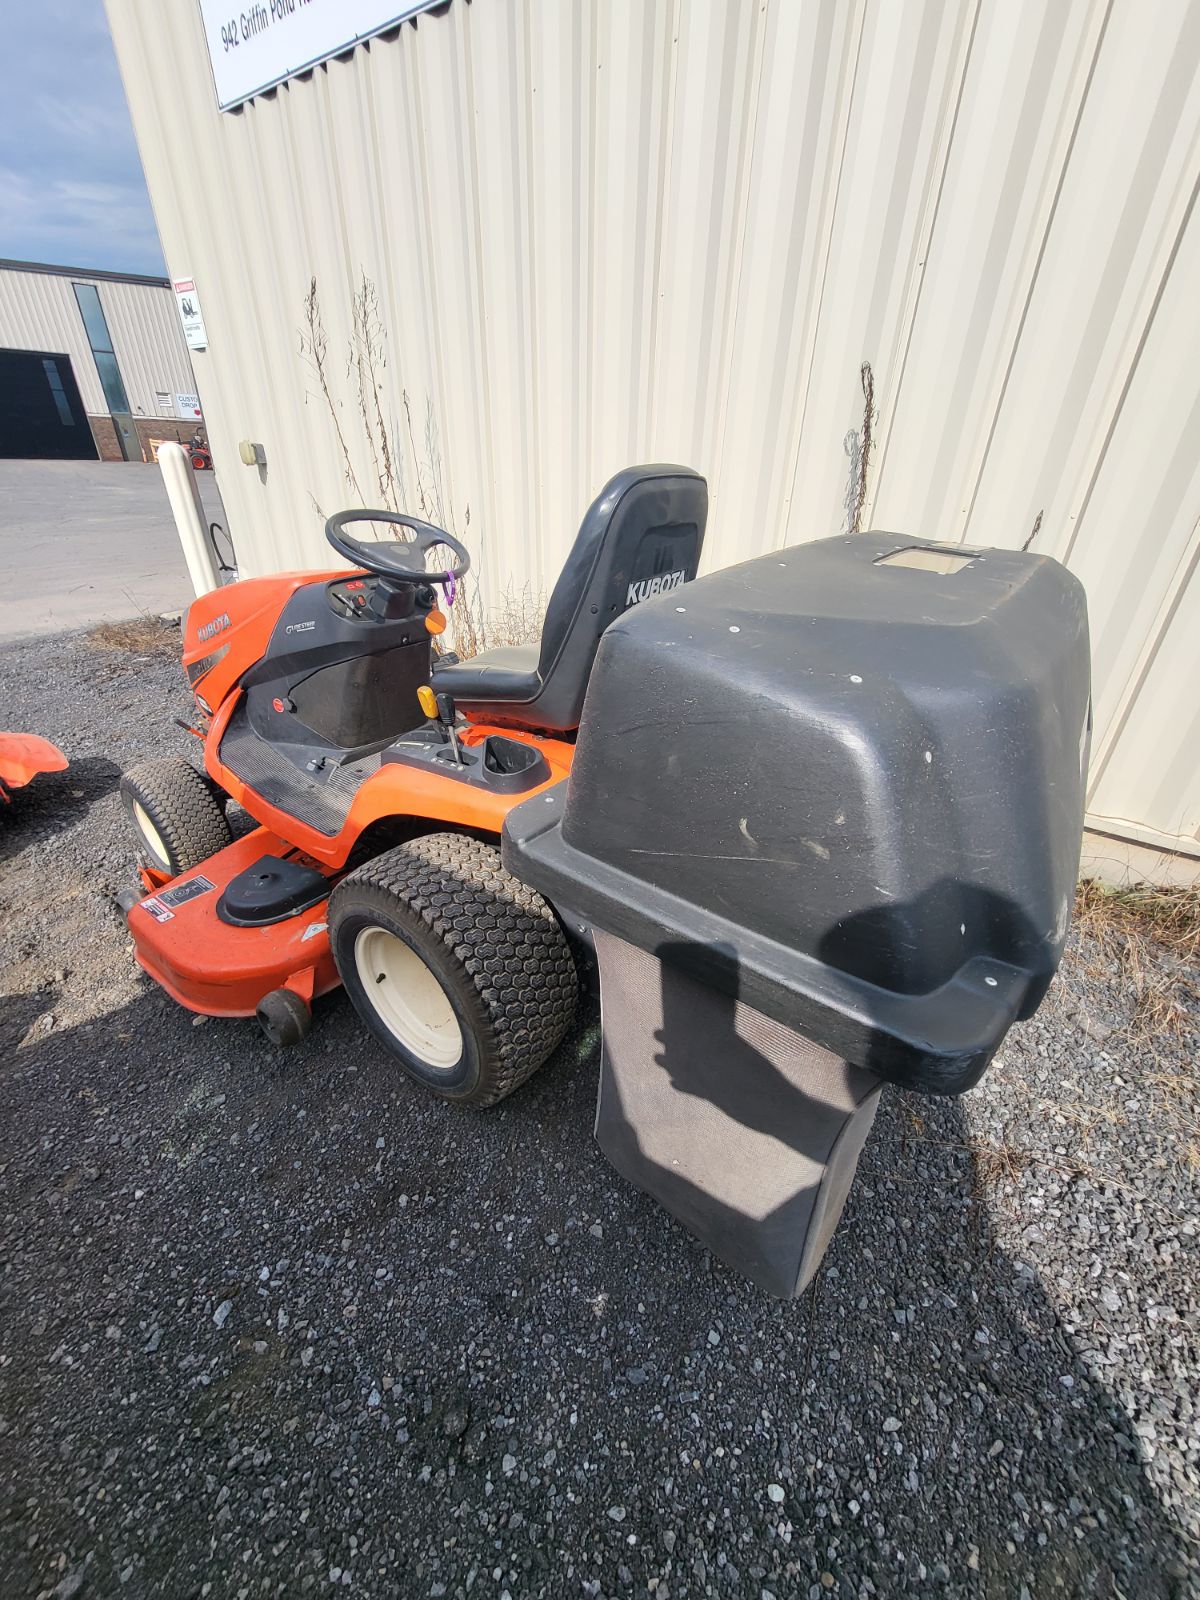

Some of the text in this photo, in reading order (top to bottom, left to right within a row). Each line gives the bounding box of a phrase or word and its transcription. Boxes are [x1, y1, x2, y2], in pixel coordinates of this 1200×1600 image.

[221, 19, 239, 52] 942
[240, 3, 269, 41] Griffin
[625, 569, 686, 606] KUBOTA
[197, 611, 232, 642] KUBOTA
